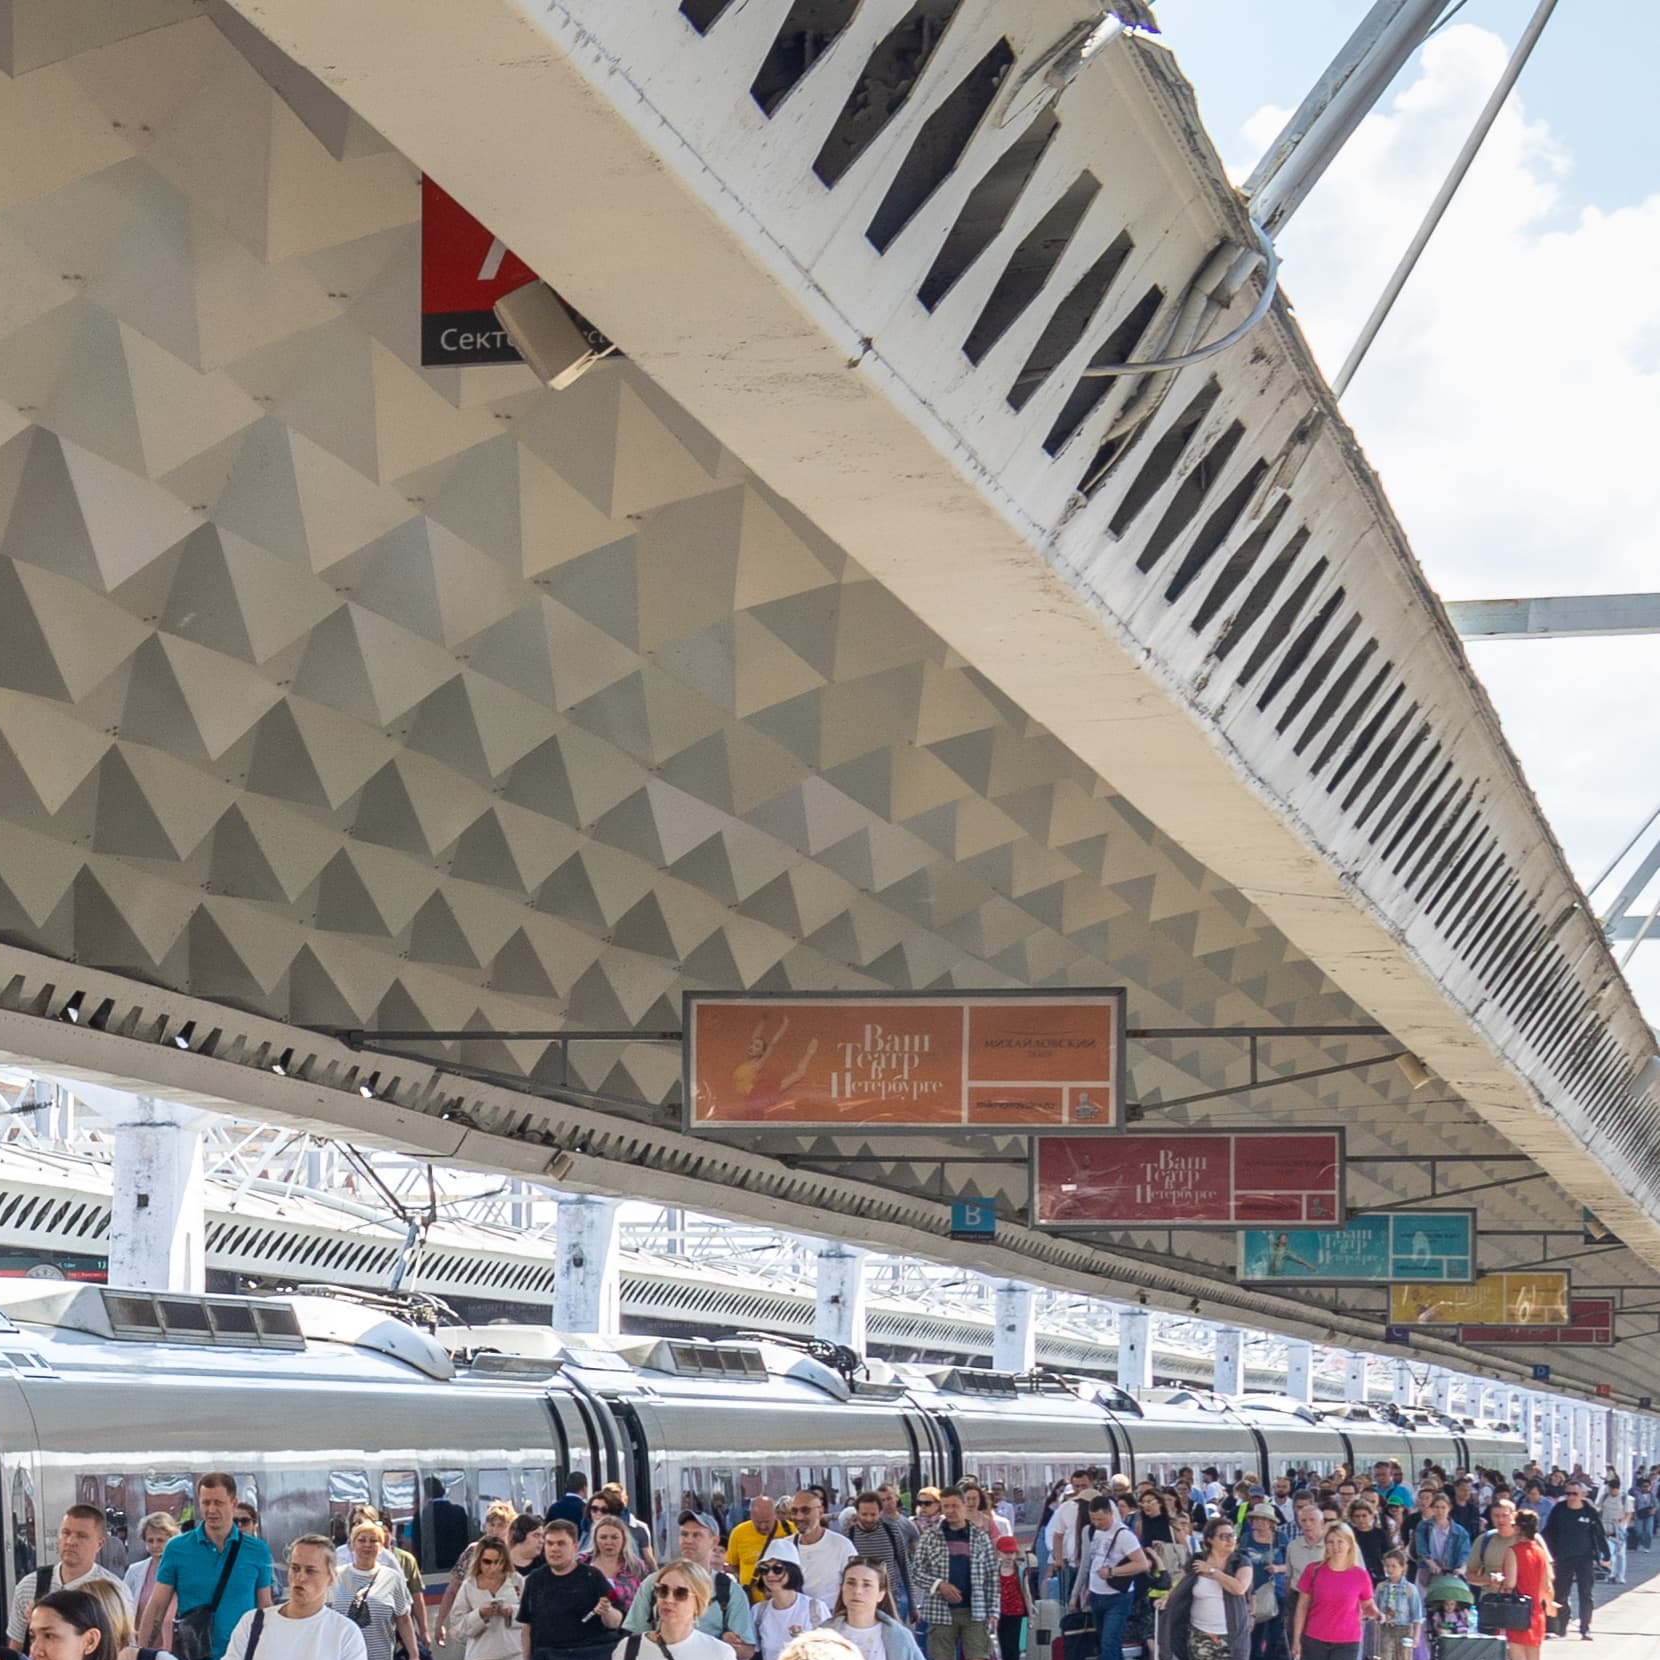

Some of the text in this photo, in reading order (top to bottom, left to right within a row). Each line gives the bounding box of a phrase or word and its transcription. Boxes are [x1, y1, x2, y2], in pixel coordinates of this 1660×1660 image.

[864, 1023, 931, 1052] Ваш
[836, 1042, 920, 1080] Театр
[830, 1072, 945, 1101] Петербурге
